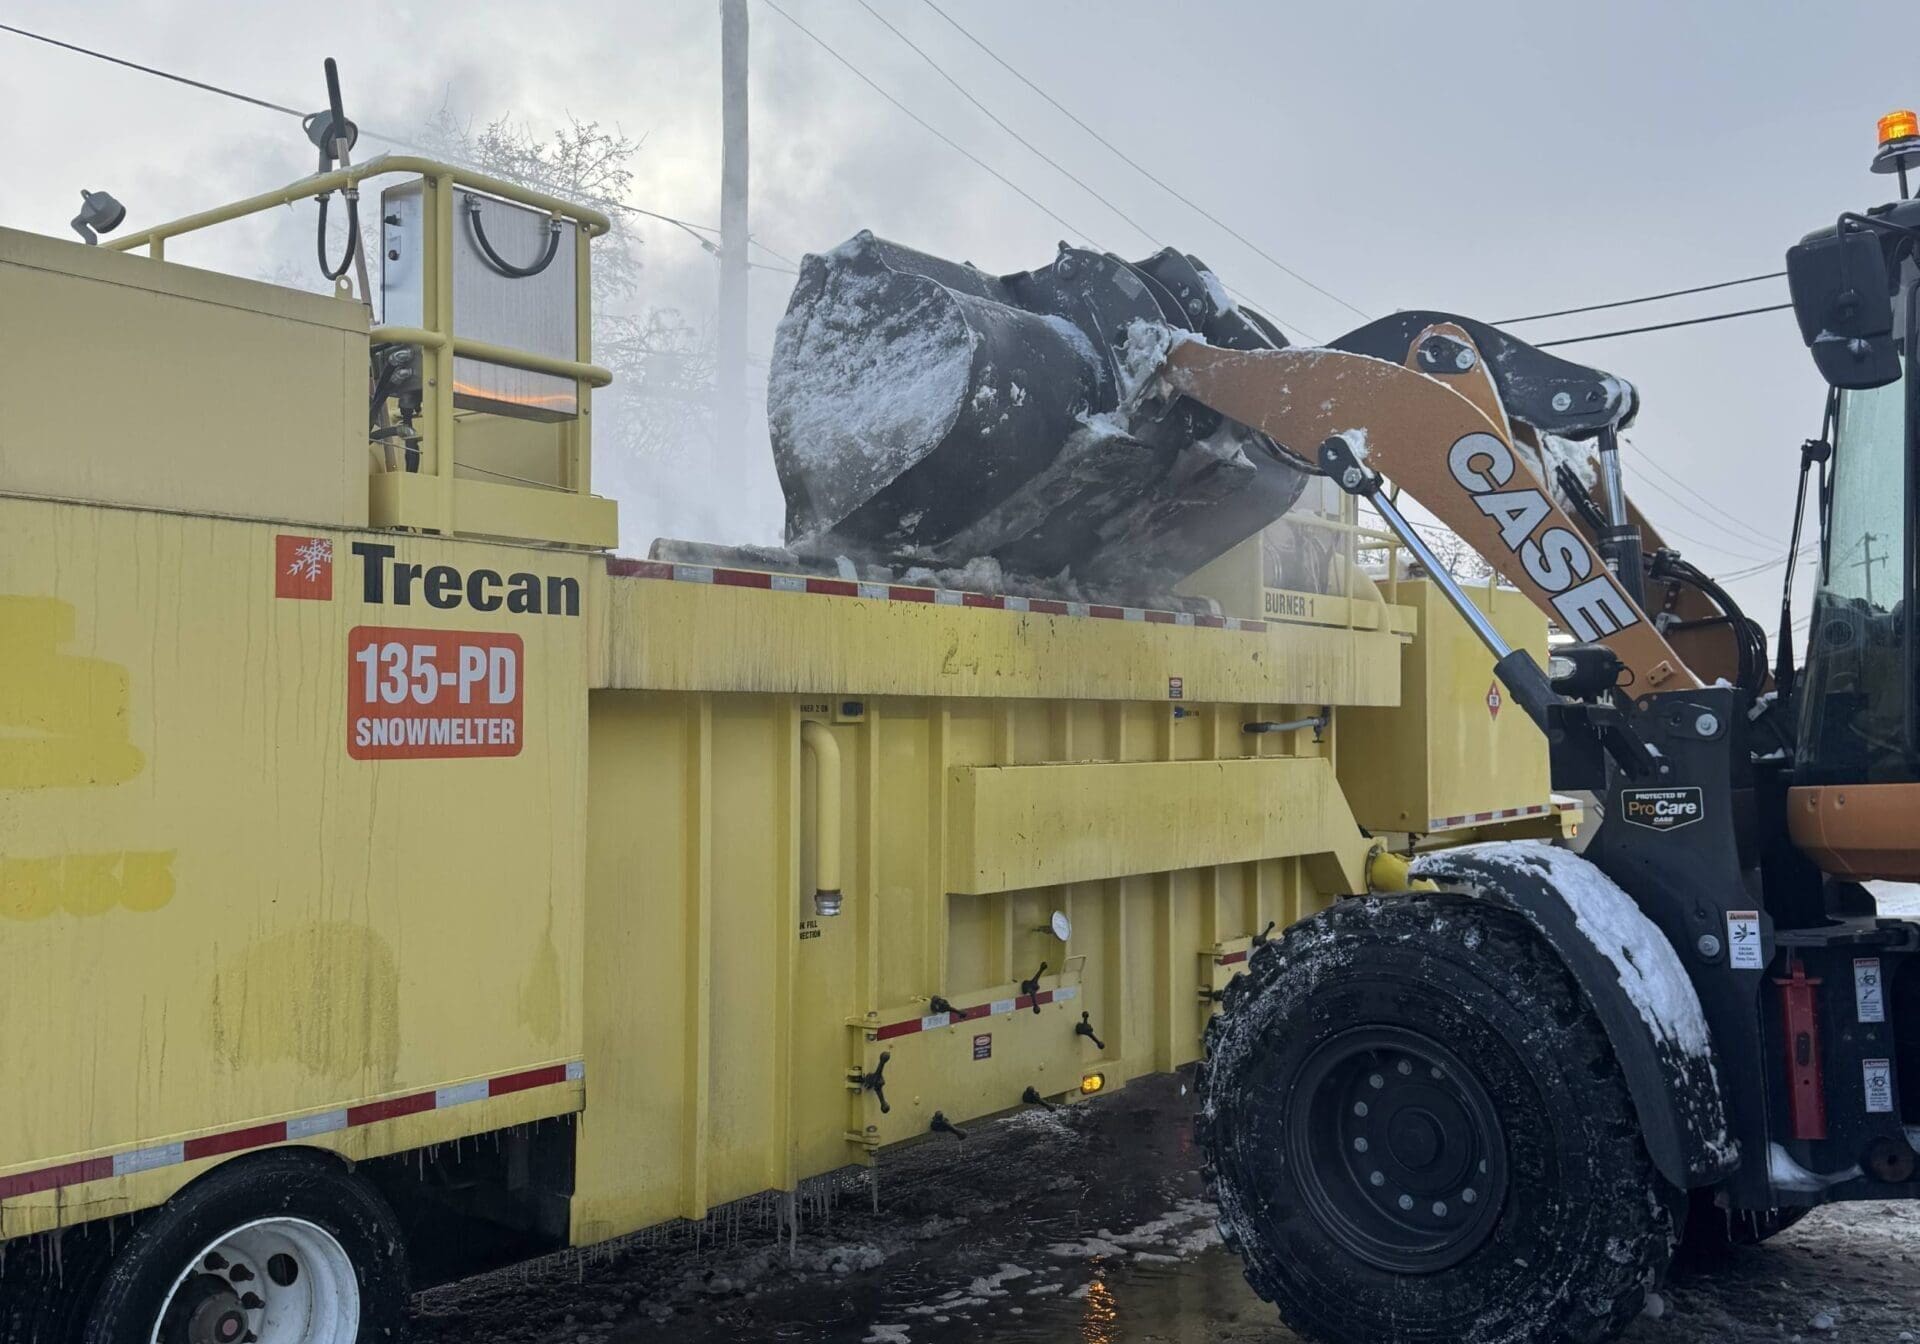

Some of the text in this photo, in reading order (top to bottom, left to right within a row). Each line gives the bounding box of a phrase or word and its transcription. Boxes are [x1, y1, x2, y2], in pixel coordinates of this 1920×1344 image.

[1447, 431, 1641, 644] CASE
[352, 541, 580, 616] Trecan
[1265, 592, 1315, 617] BURNER 1
[356, 642, 516, 704] 135-PD
[356, 717, 515, 746] SNOWMELTER
[1628, 800, 1697, 816] ProCare
[1635, 792, 1676, 800] PROTECTED
[807, 920, 818, 928] FILL
